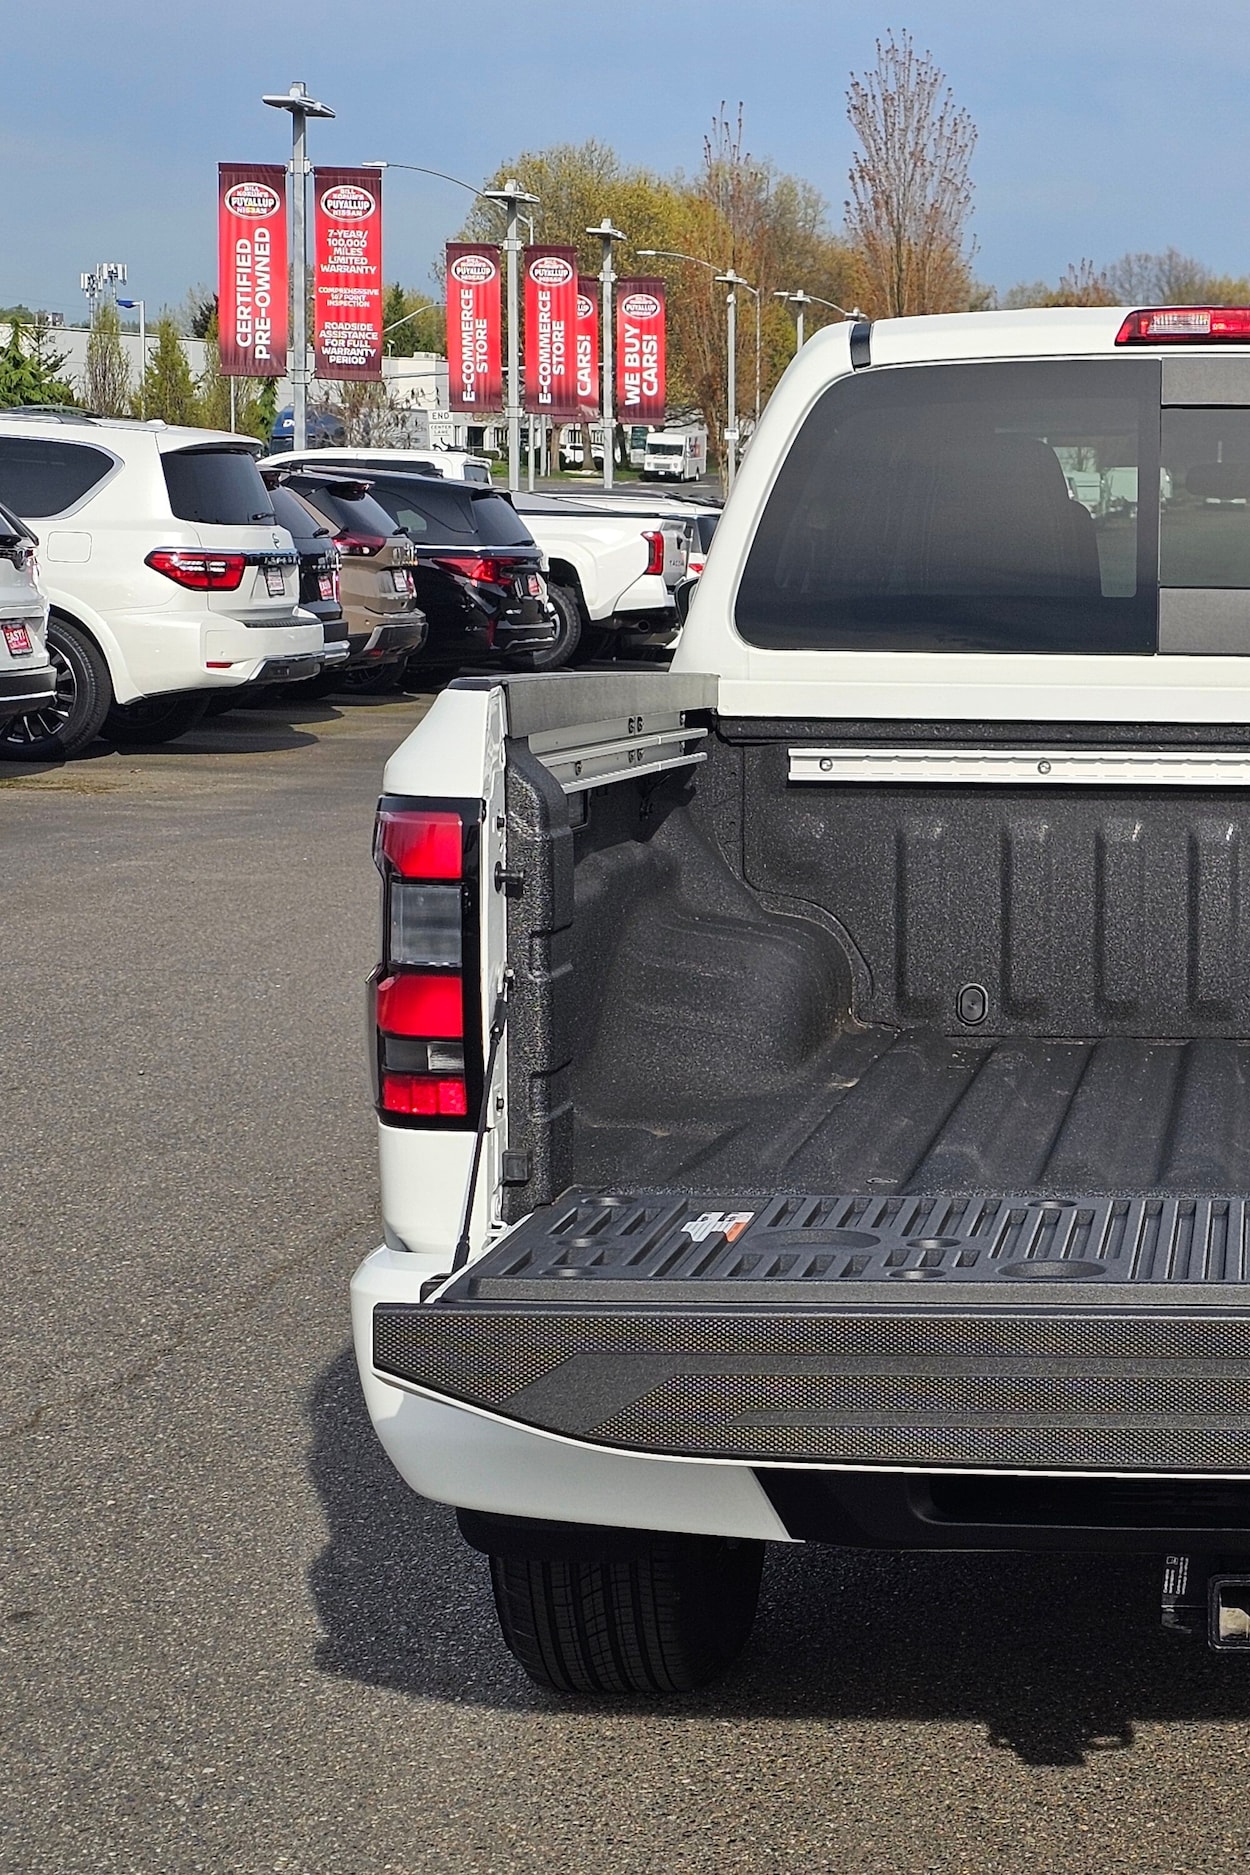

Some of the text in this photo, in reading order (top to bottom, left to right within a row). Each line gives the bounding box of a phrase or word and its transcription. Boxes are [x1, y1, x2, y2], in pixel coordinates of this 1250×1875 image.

[231, 197, 275, 208] PUYALLUP
[327, 199, 370, 211] PUYALLUP
[327, 229, 368, 240] 7-YEAR/
[326, 238, 367, 248] 100,000
[333, 247, 363, 256] MILES
[328, 255, 368, 265] LIMITED
[320, 264, 376, 274] WARRANTY
[456, 266, 491, 275] PUYALLUP
[236, 238, 252, 348] CERTIFIED
[254, 227, 271, 360] PRE-OWNED
[324, 321, 374, 331] ROADSIDE
[319, 330, 378, 340] ASSISTANCE
[324, 338, 371, 348] FOR FULL
[460, 288, 475, 402] E-COMMERCE
[475, 318, 488, 373] STORE
[538, 290, 551, 404] E-COMMERCE
[552, 320, 565, 375] STORE
[624, 324, 641, 368] BUY
[321, 346, 376, 357] WARRANTY
[329, 355, 366, 365] PERIOD
[576, 334, 591, 397] CARS!
[642, 334, 658, 397] CARS!
[624, 372, 641, 406] WE
[432, 411, 450, 420] END
